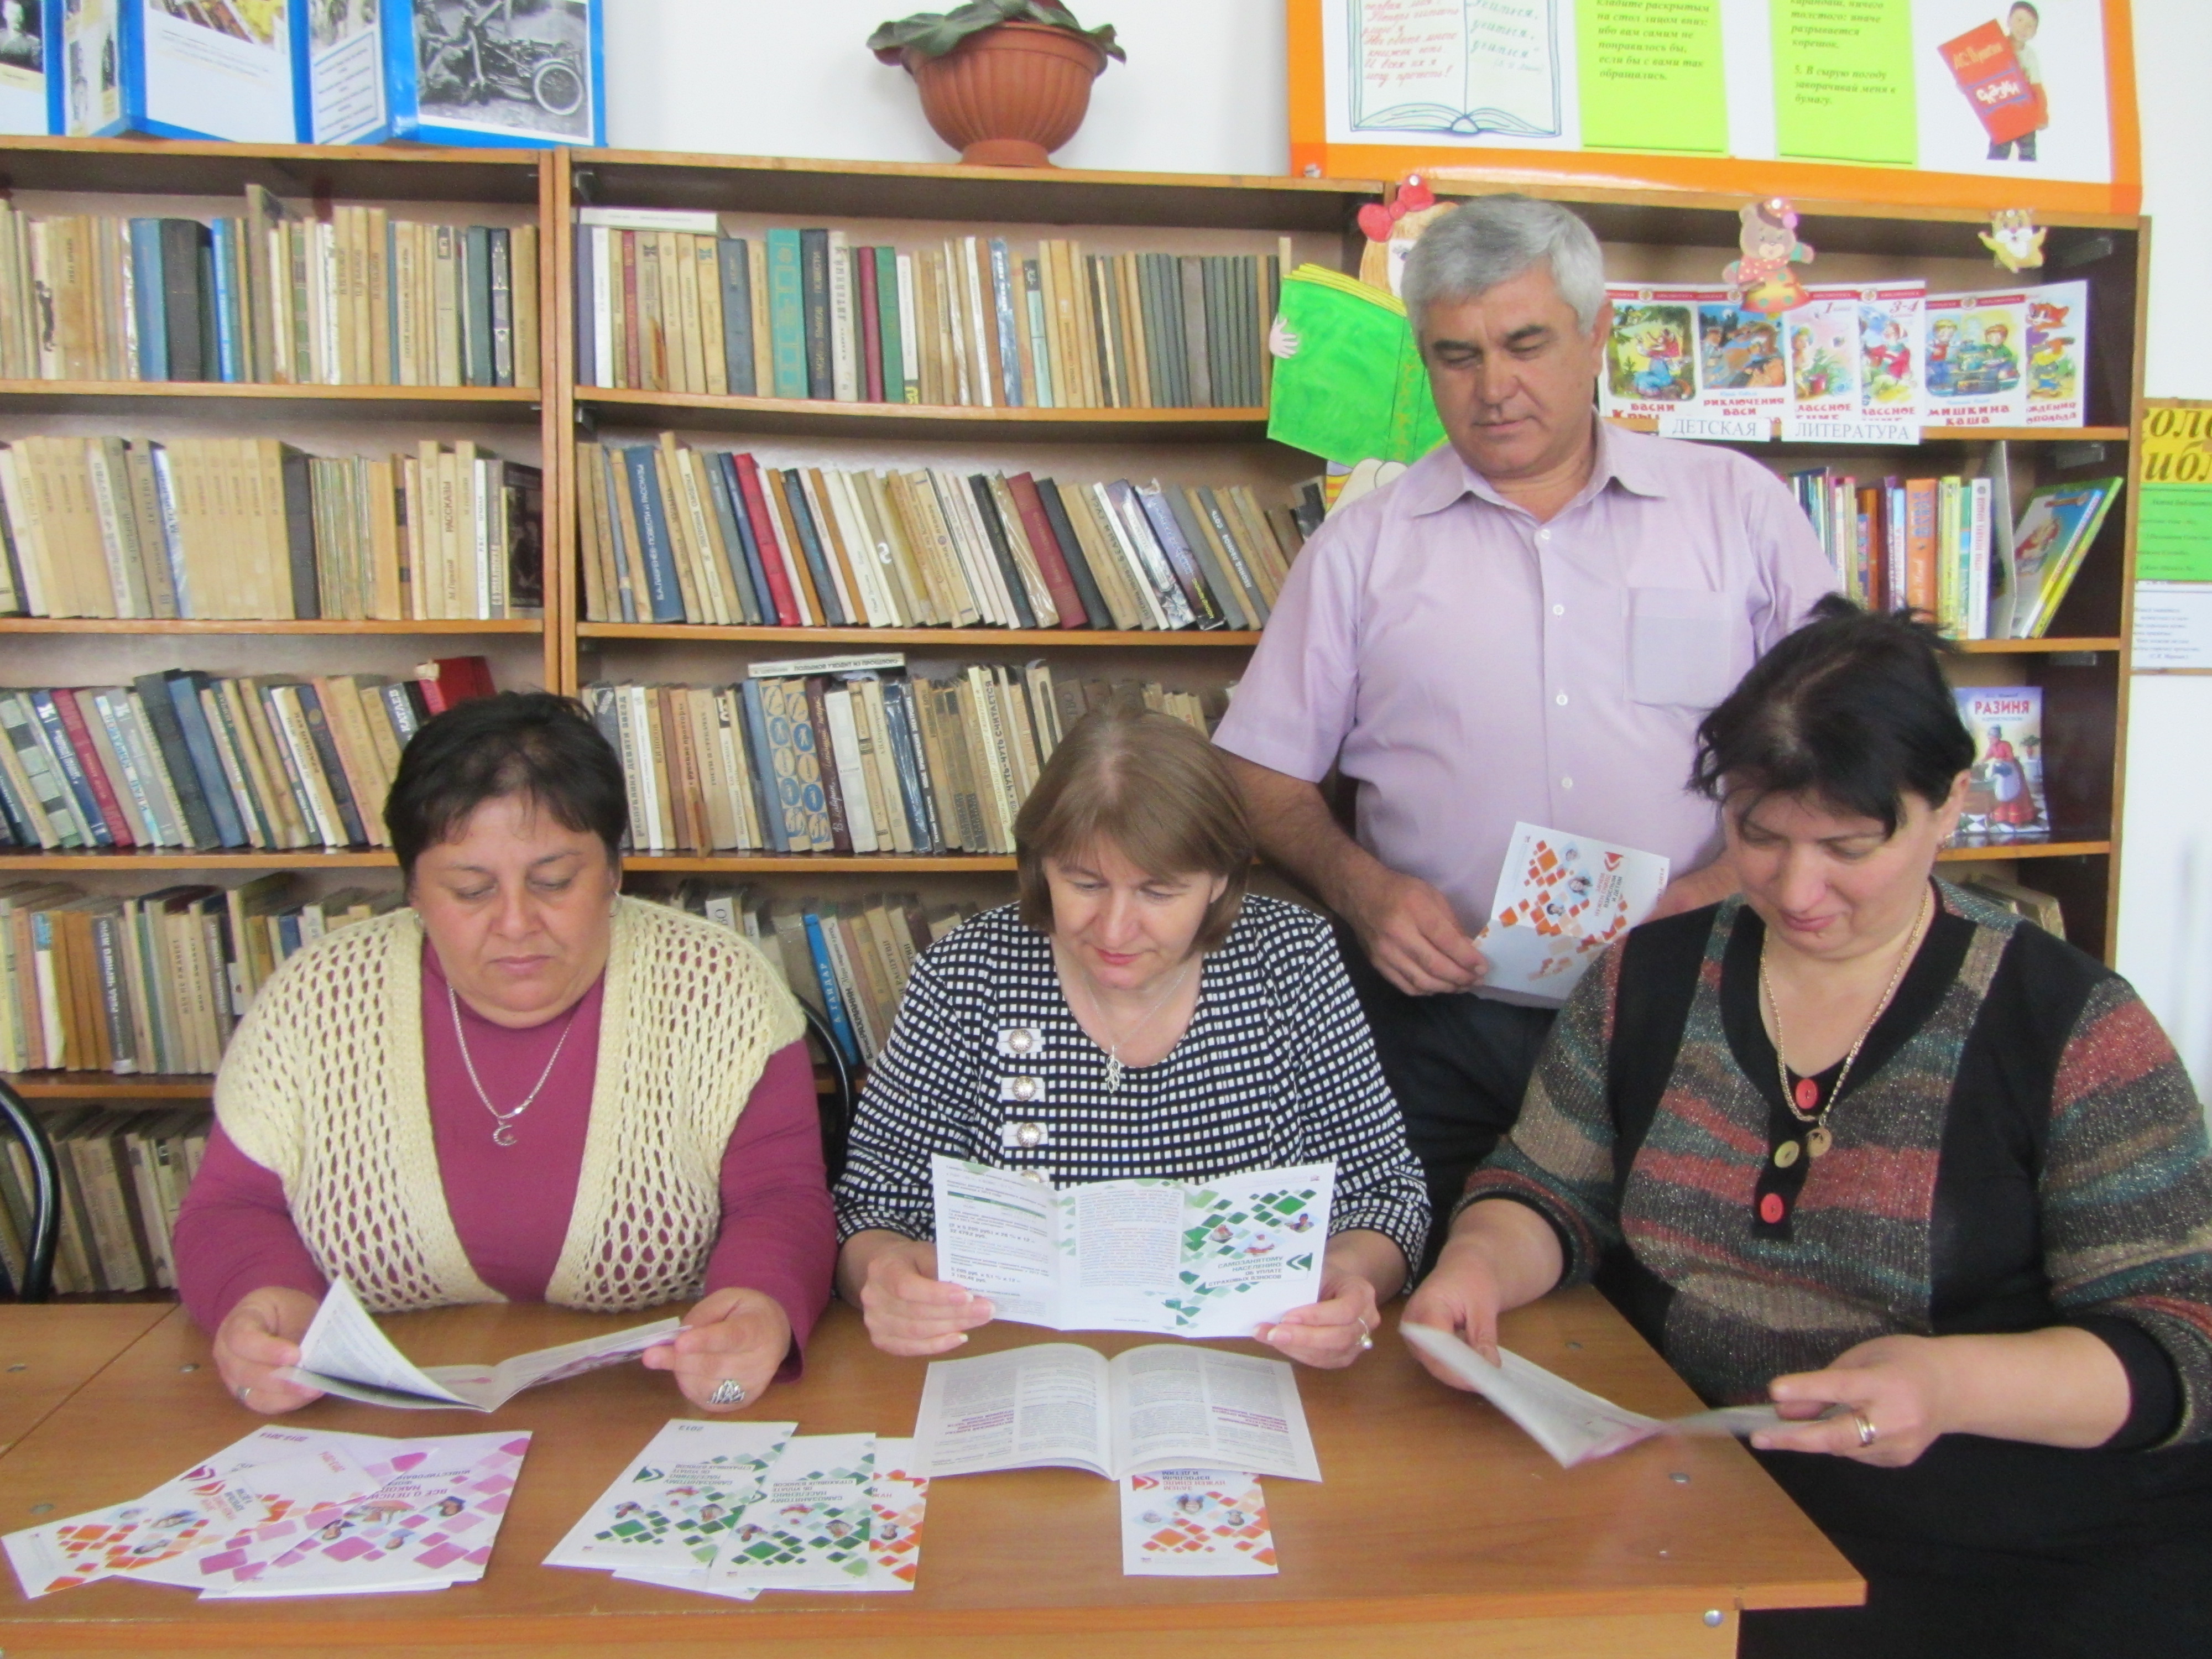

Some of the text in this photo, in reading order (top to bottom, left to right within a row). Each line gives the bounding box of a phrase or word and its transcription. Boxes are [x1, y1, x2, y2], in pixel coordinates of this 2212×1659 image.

[1646, 1, 1709, 12] раскрытым
[1849, 1, 1884, 9] ничего
[1613, 14, 1640, 22] стол
[1645, 16, 1677, 24] лицом
[1850, 14, 1881, 23] иначе
[1598, 25, 1617, 34] ибо
[1643, 29, 1678, 38] самим
[1791, 25, 1859, 35] разрывается
[1599, 41, 1666, 51] понравилось
[1792, 39, 1839, 49] корешок.
[1626, 55, 1640, 65] бы
[1599, 68, 1667, 80] обращались.
[1794, 64, 1887, 81] 5. В сырую погоду
[1796, 81, 1858, 92] заворачивай
[1795, 93, 1832, 106] бумагу.
[1631, 403, 1676, 413] БАСНИ
[1723, 408, 1757, 416] ВАСИ
[1927, 405, 2010, 416] МИШКИНА
[1945, 416, 1990, 425] КАША
[1672, 418, 1910, 441] ДЕТСКАЯ ЛИТЕРАТУРА
[637, 463, 649, 503] РАССКАЗЫ
[685, 473, 698, 507] САМОДЕЛКИ
[444, 481, 453, 533] РАССКАЗЫ
[1091, 495, 1105, 519] ГУСЬ
[1211, 510, 1252, 588] ЛЕОНИД ЛЕОНОВ СОТЬ
[389, 689, 411, 733] КАТАЕВ
[813, 696, 826, 726] почерк
[906, 696, 918, 731] ЭЛЕКТРОНИКА
[1974, 700, 2031, 715] РАЗИНЯ
[985, 680, 1013, 791] ЧУТЬ-ЧУТЬ СЧИТАЕТСЯ
[914, 734, 926, 770] ПРИКЛЮЧЕНИЯ
[618, 696, 644, 837] РЕСПУБЛИКА ДЕВЯТИ ЗВЕЗД
[920, 772, 929, 788] НОВЫЕ
[833, 822, 843, 832] В.
[930, 823, 940, 843] Евгений
[172, 938, 184, 979] РЖАВЕЕТ
[883, 940, 903, 985] РАСПУТИН
[820, 963, 837, 1009] ГАЙДАР
[846, 988, 868, 1039] РАХМАНИН
[1218, 1256, 1283, 1269] САМОЗАНЯТОМУ
[1208, 1276, 1249, 1287] СТРАХОВЫХ
